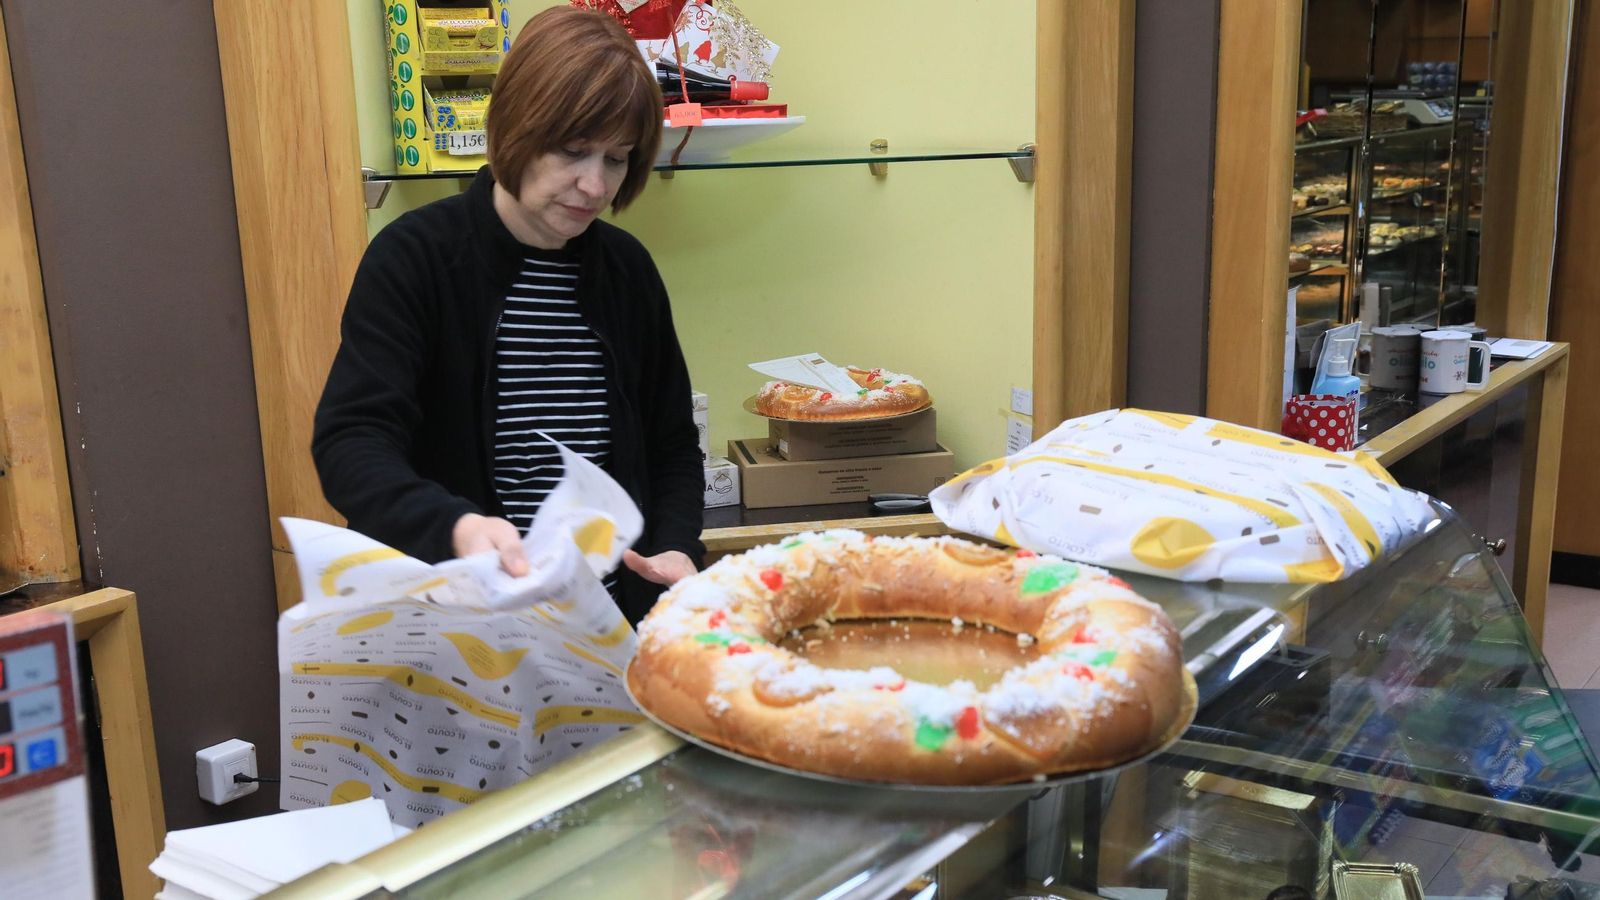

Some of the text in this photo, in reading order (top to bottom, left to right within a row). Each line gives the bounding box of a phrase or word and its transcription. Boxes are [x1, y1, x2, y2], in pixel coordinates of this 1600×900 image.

[450, 134, 485, 149] 1,15€
[1048, 536, 1085, 554] COUTO
[342, 696, 371, 704] COUTO
[389, 691, 413, 706] COUTO
[340, 725, 367, 738] COUTO
[384, 727, 406, 745] COUTO
[427, 728, 456, 738] COUTO
[292, 761, 319, 770] COUTO
[338, 756, 362, 771] COUTO
[469, 757, 497, 770] COUTO
[416, 766, 444, 776] COUTO
[406, 804, 444, 816] EL COUTO
